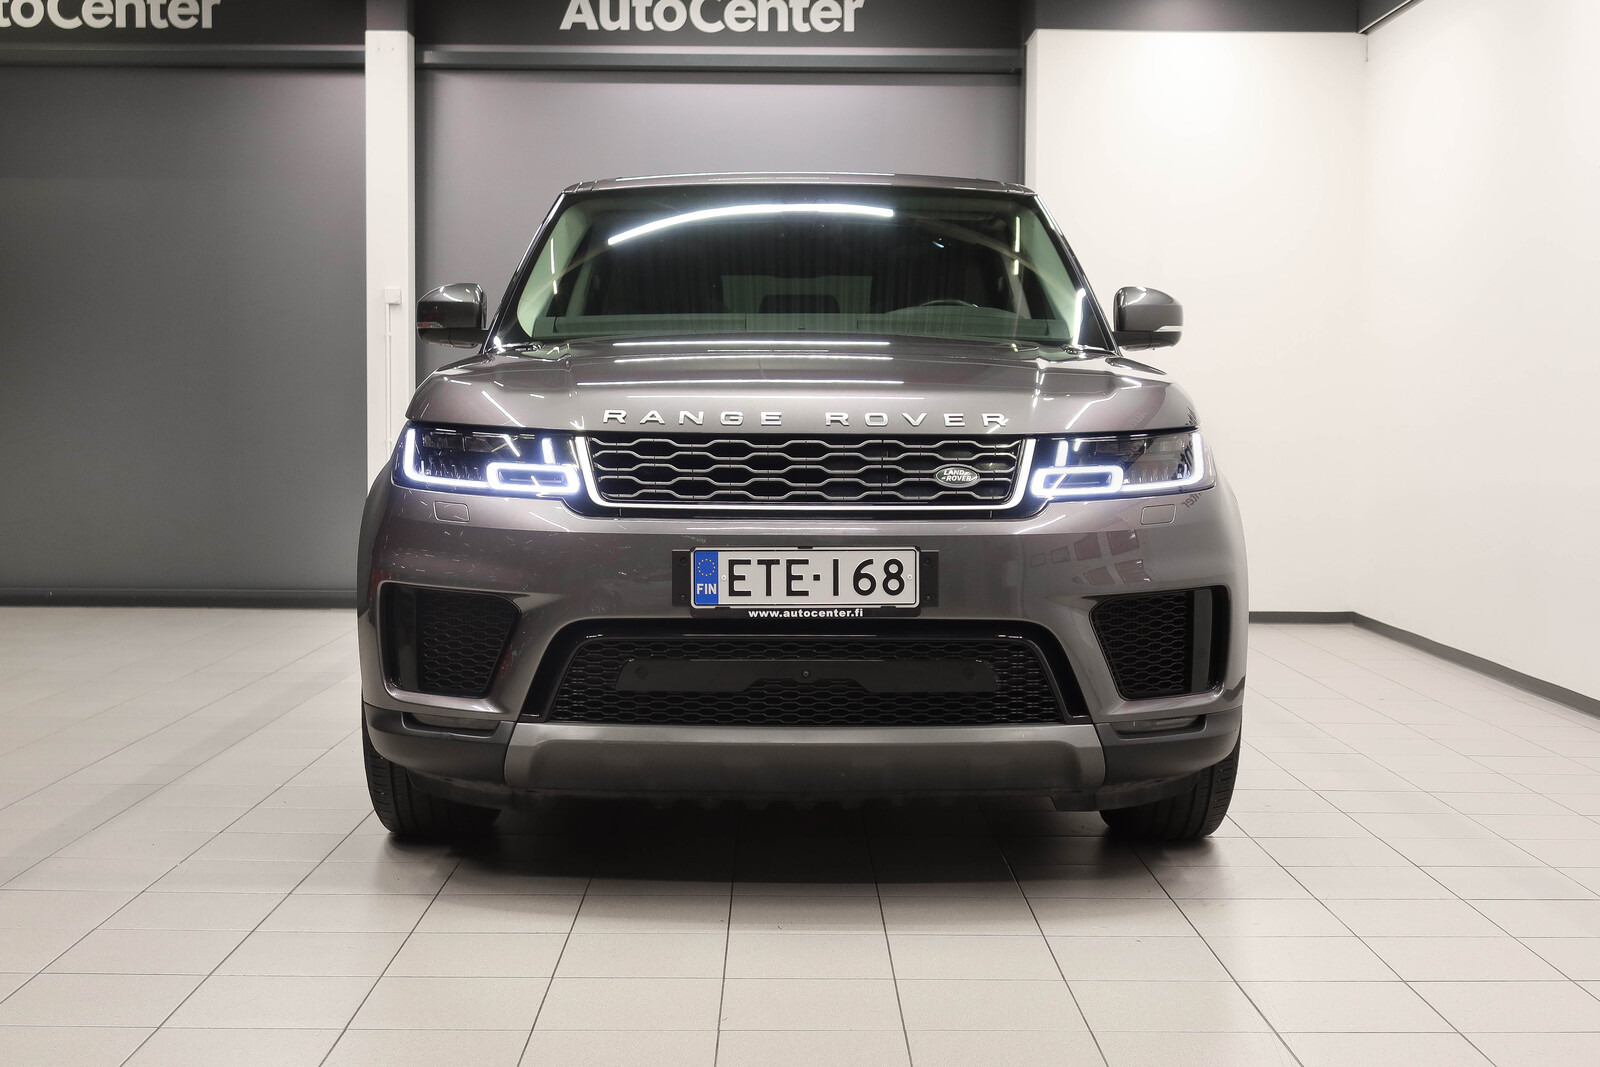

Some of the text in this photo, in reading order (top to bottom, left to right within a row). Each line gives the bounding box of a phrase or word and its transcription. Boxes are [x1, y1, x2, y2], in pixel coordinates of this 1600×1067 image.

[559, 0, 864, 33] AutoCenter
[602, 409, 1009, 428] RANGE ROVER
[696, 583, 717, 595] FIN
[748, 608, 864, 618] www.autocenter.fi
